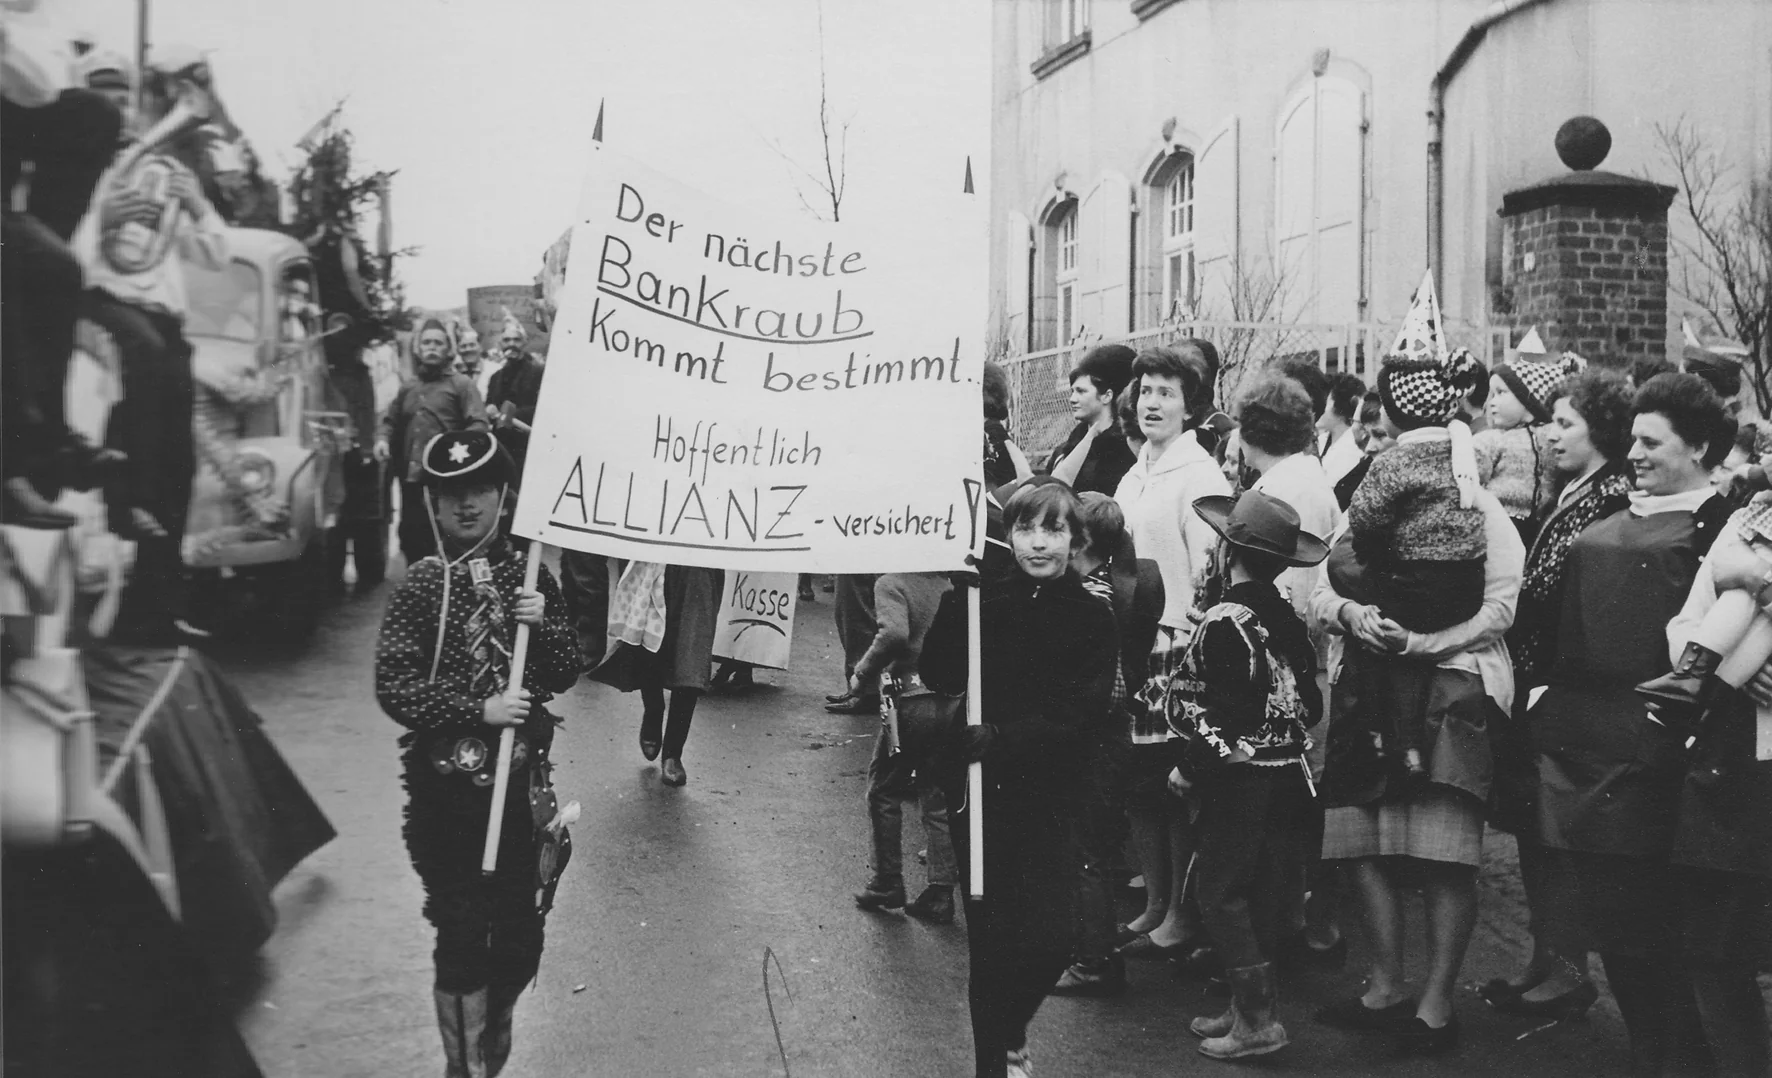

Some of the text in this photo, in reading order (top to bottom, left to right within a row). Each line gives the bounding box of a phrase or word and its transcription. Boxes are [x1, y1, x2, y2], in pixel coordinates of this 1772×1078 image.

[616, 182, 868, 278] Der nächste
[654, 414, 822, 487] Hoffentlich
[552, 456, 808, 543] ALLIANZ
[731, 571, 790, 621] Kasse
